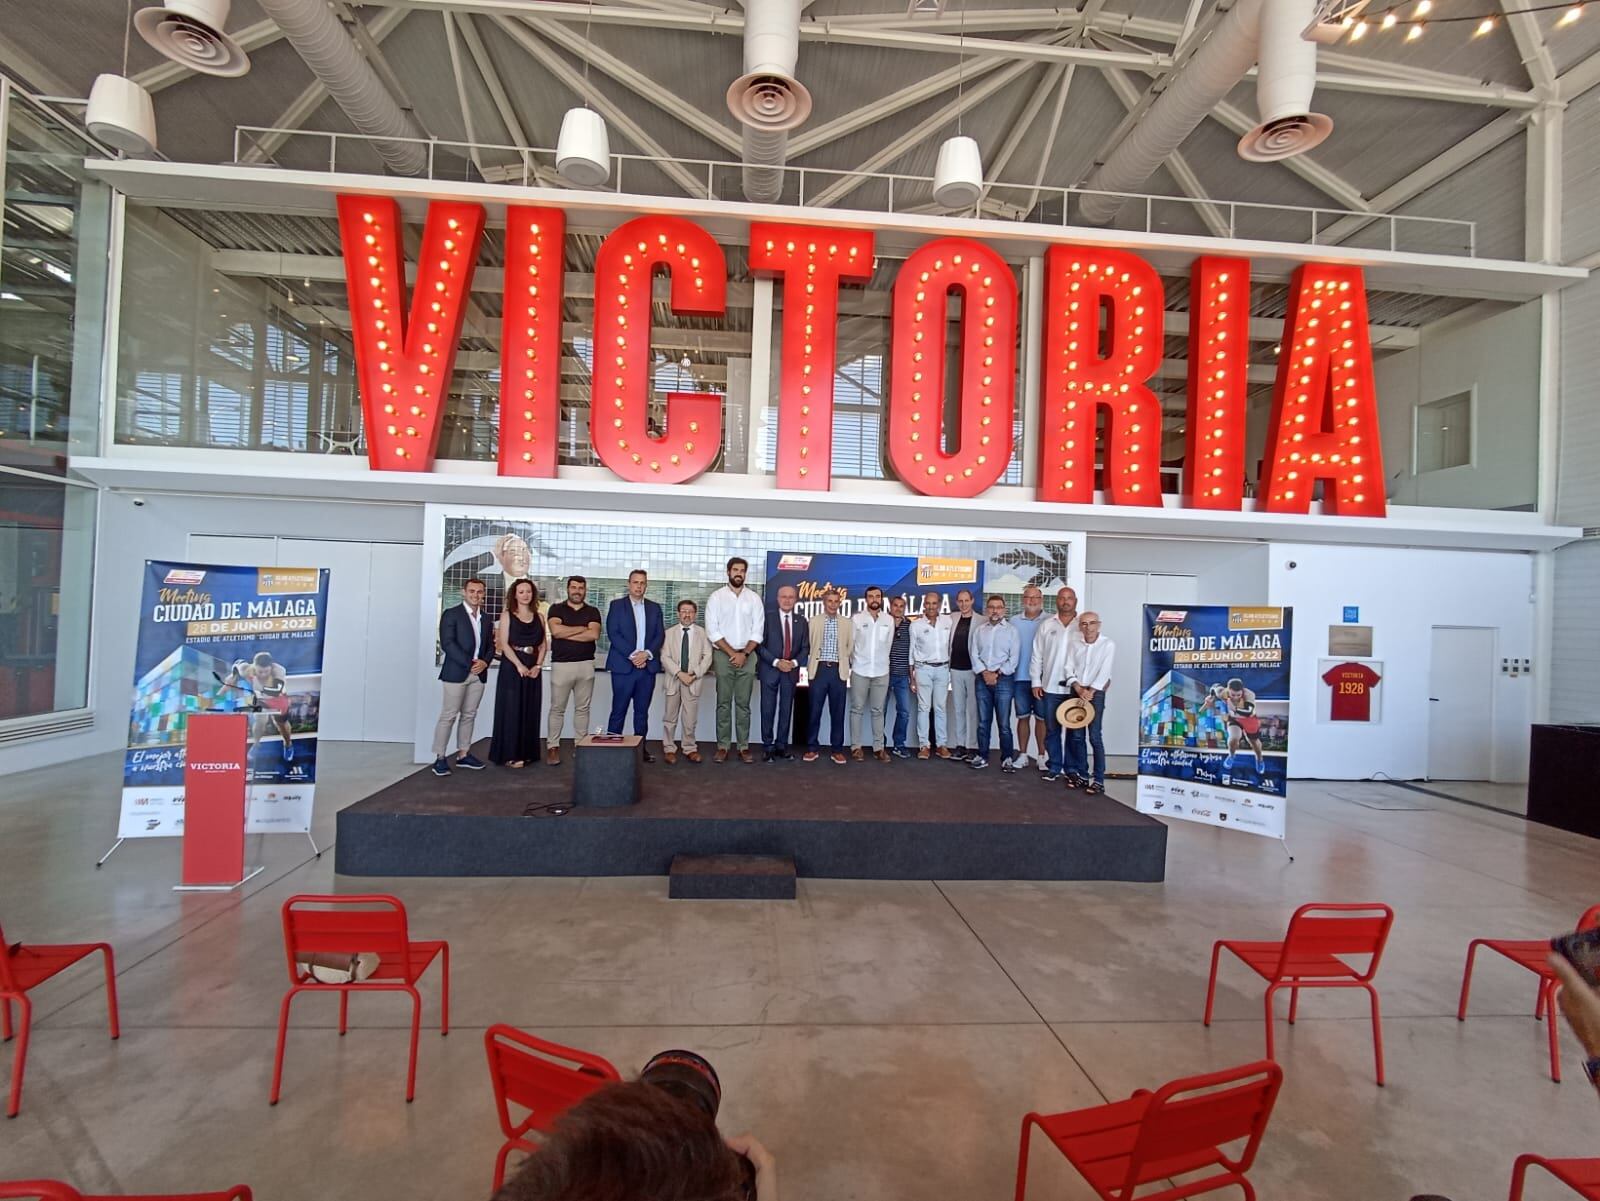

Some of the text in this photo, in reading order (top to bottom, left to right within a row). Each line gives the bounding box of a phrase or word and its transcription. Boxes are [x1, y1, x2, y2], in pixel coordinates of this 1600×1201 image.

[337, 194, 1386, 517] VICTORIA
[153, 599, 317, 622] CIUDAD DE MÁLAGA
[193, 618, 313, 635] 28 DE JUNIO 2022
[186, 636, 210, 644] ESTADIO
[222, 634, 256, 642] ATLETISMO
[1150, 632, 1281, 652] CIUDAD DE MÁLAGA
[1192, 652, 1206, 661] DE
[1208, 651, 1243, 661] JUNIO
[1250, 651, 1278, 660] 2022
[1339, 682, 1364, 694] 1928
